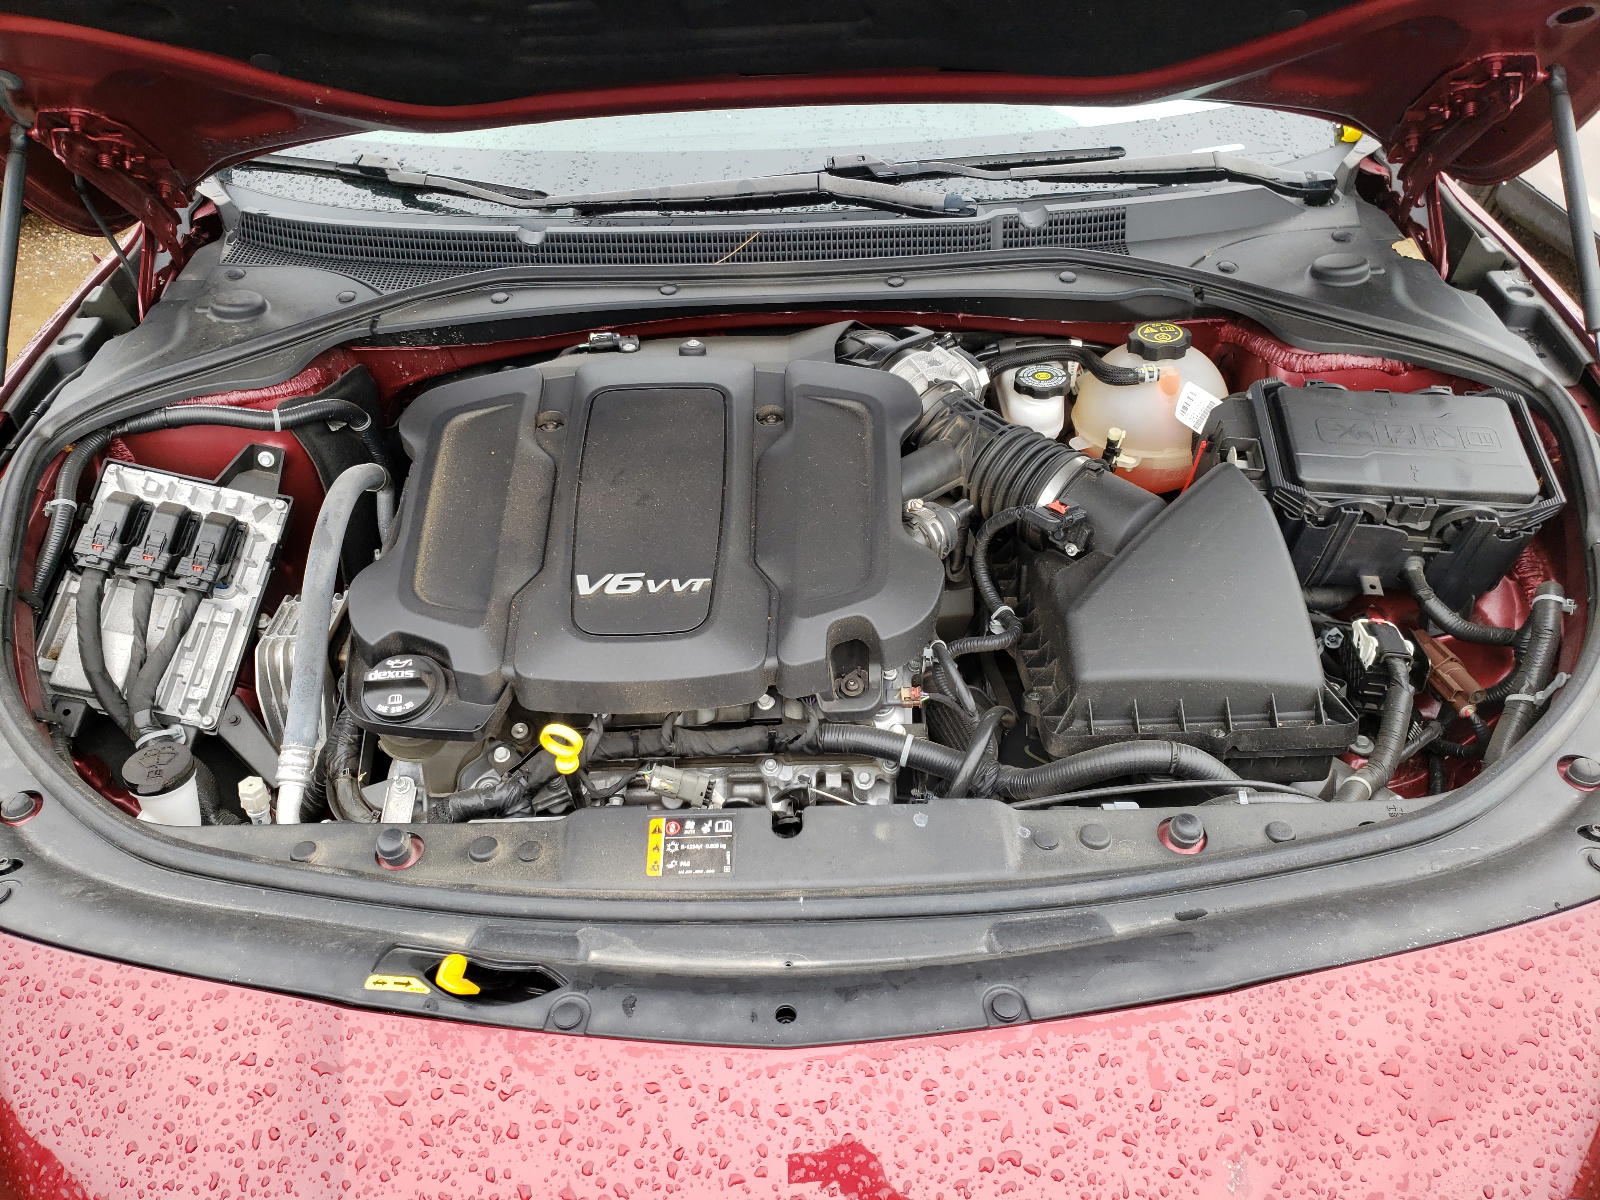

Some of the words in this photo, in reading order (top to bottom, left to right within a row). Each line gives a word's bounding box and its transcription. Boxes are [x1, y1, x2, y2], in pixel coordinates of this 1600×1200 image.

[576, 572, 645, 595] V6
[646, 578, 712, 593] VVT
[368, 669, 415, 681] dexos
